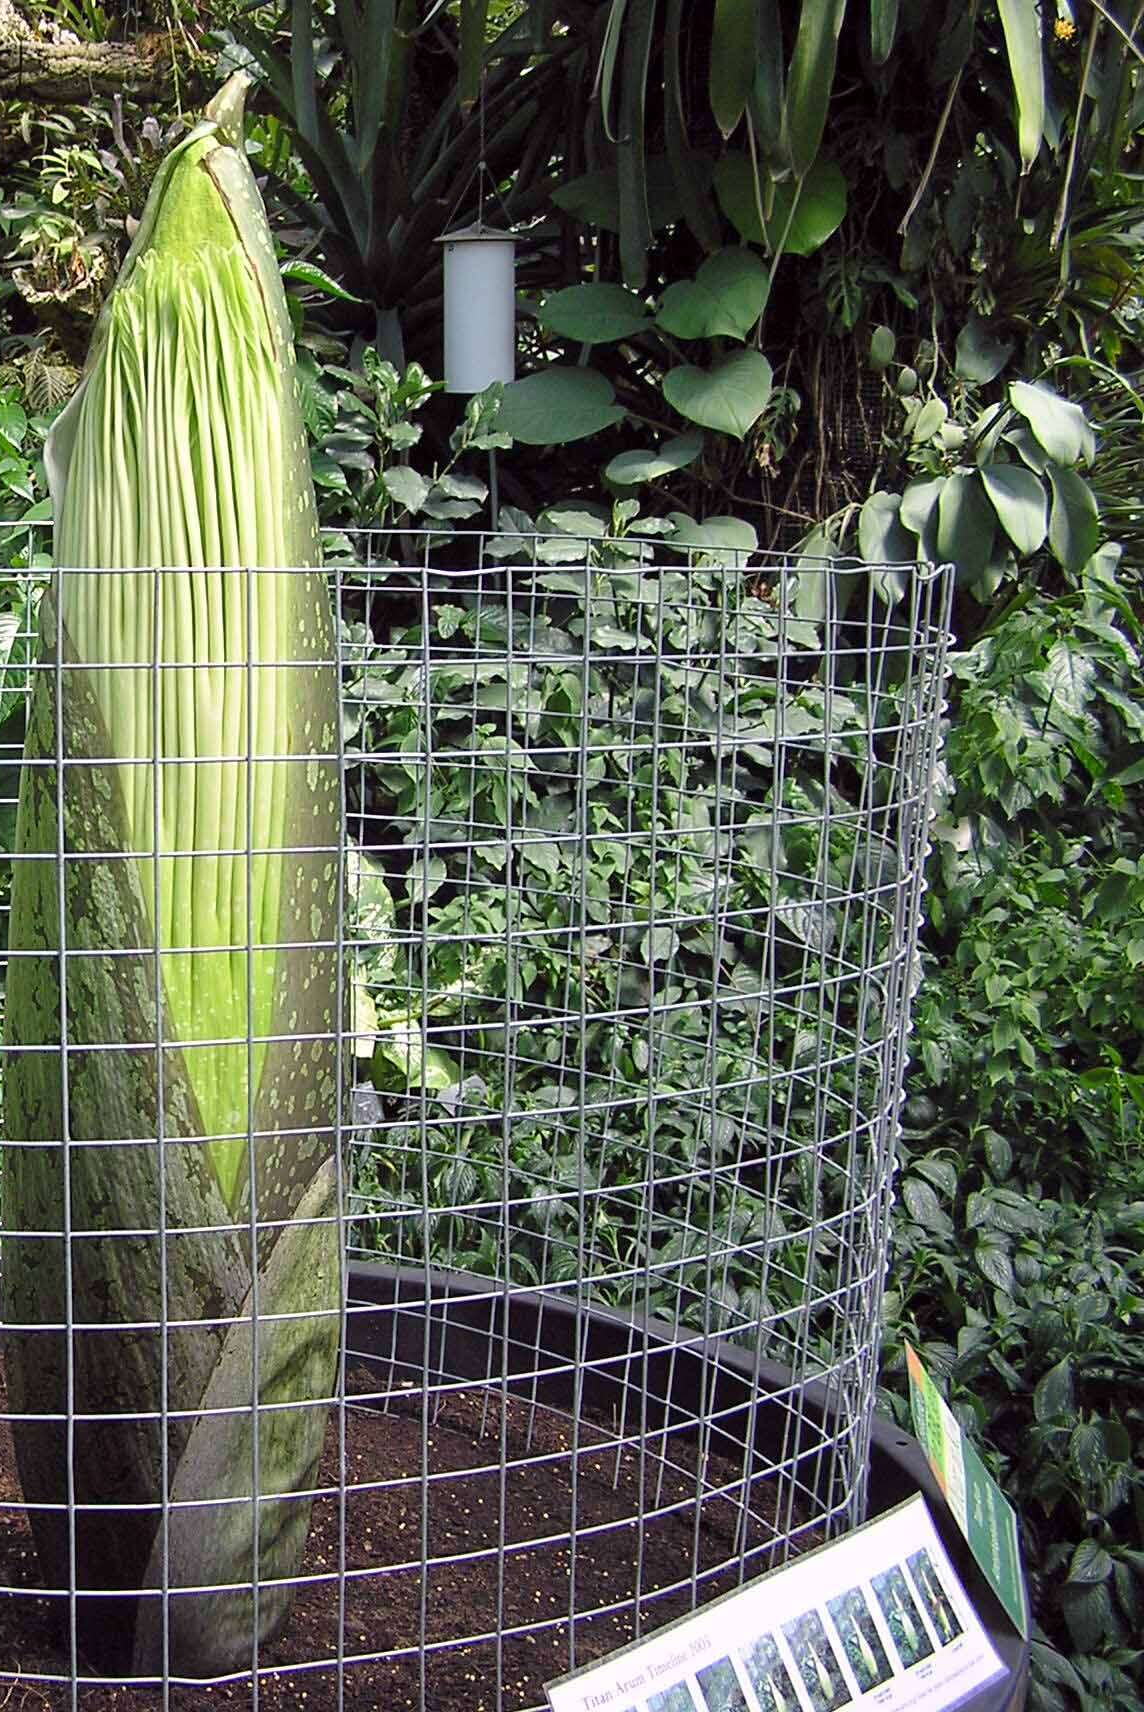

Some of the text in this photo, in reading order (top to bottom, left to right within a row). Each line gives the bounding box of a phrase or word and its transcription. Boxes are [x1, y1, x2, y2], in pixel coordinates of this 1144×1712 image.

[582, 1690, 614, 1711] Titan
[616, 1673, 646, 1695] Arum
[646, 1653, 689, 1680] Timeline
